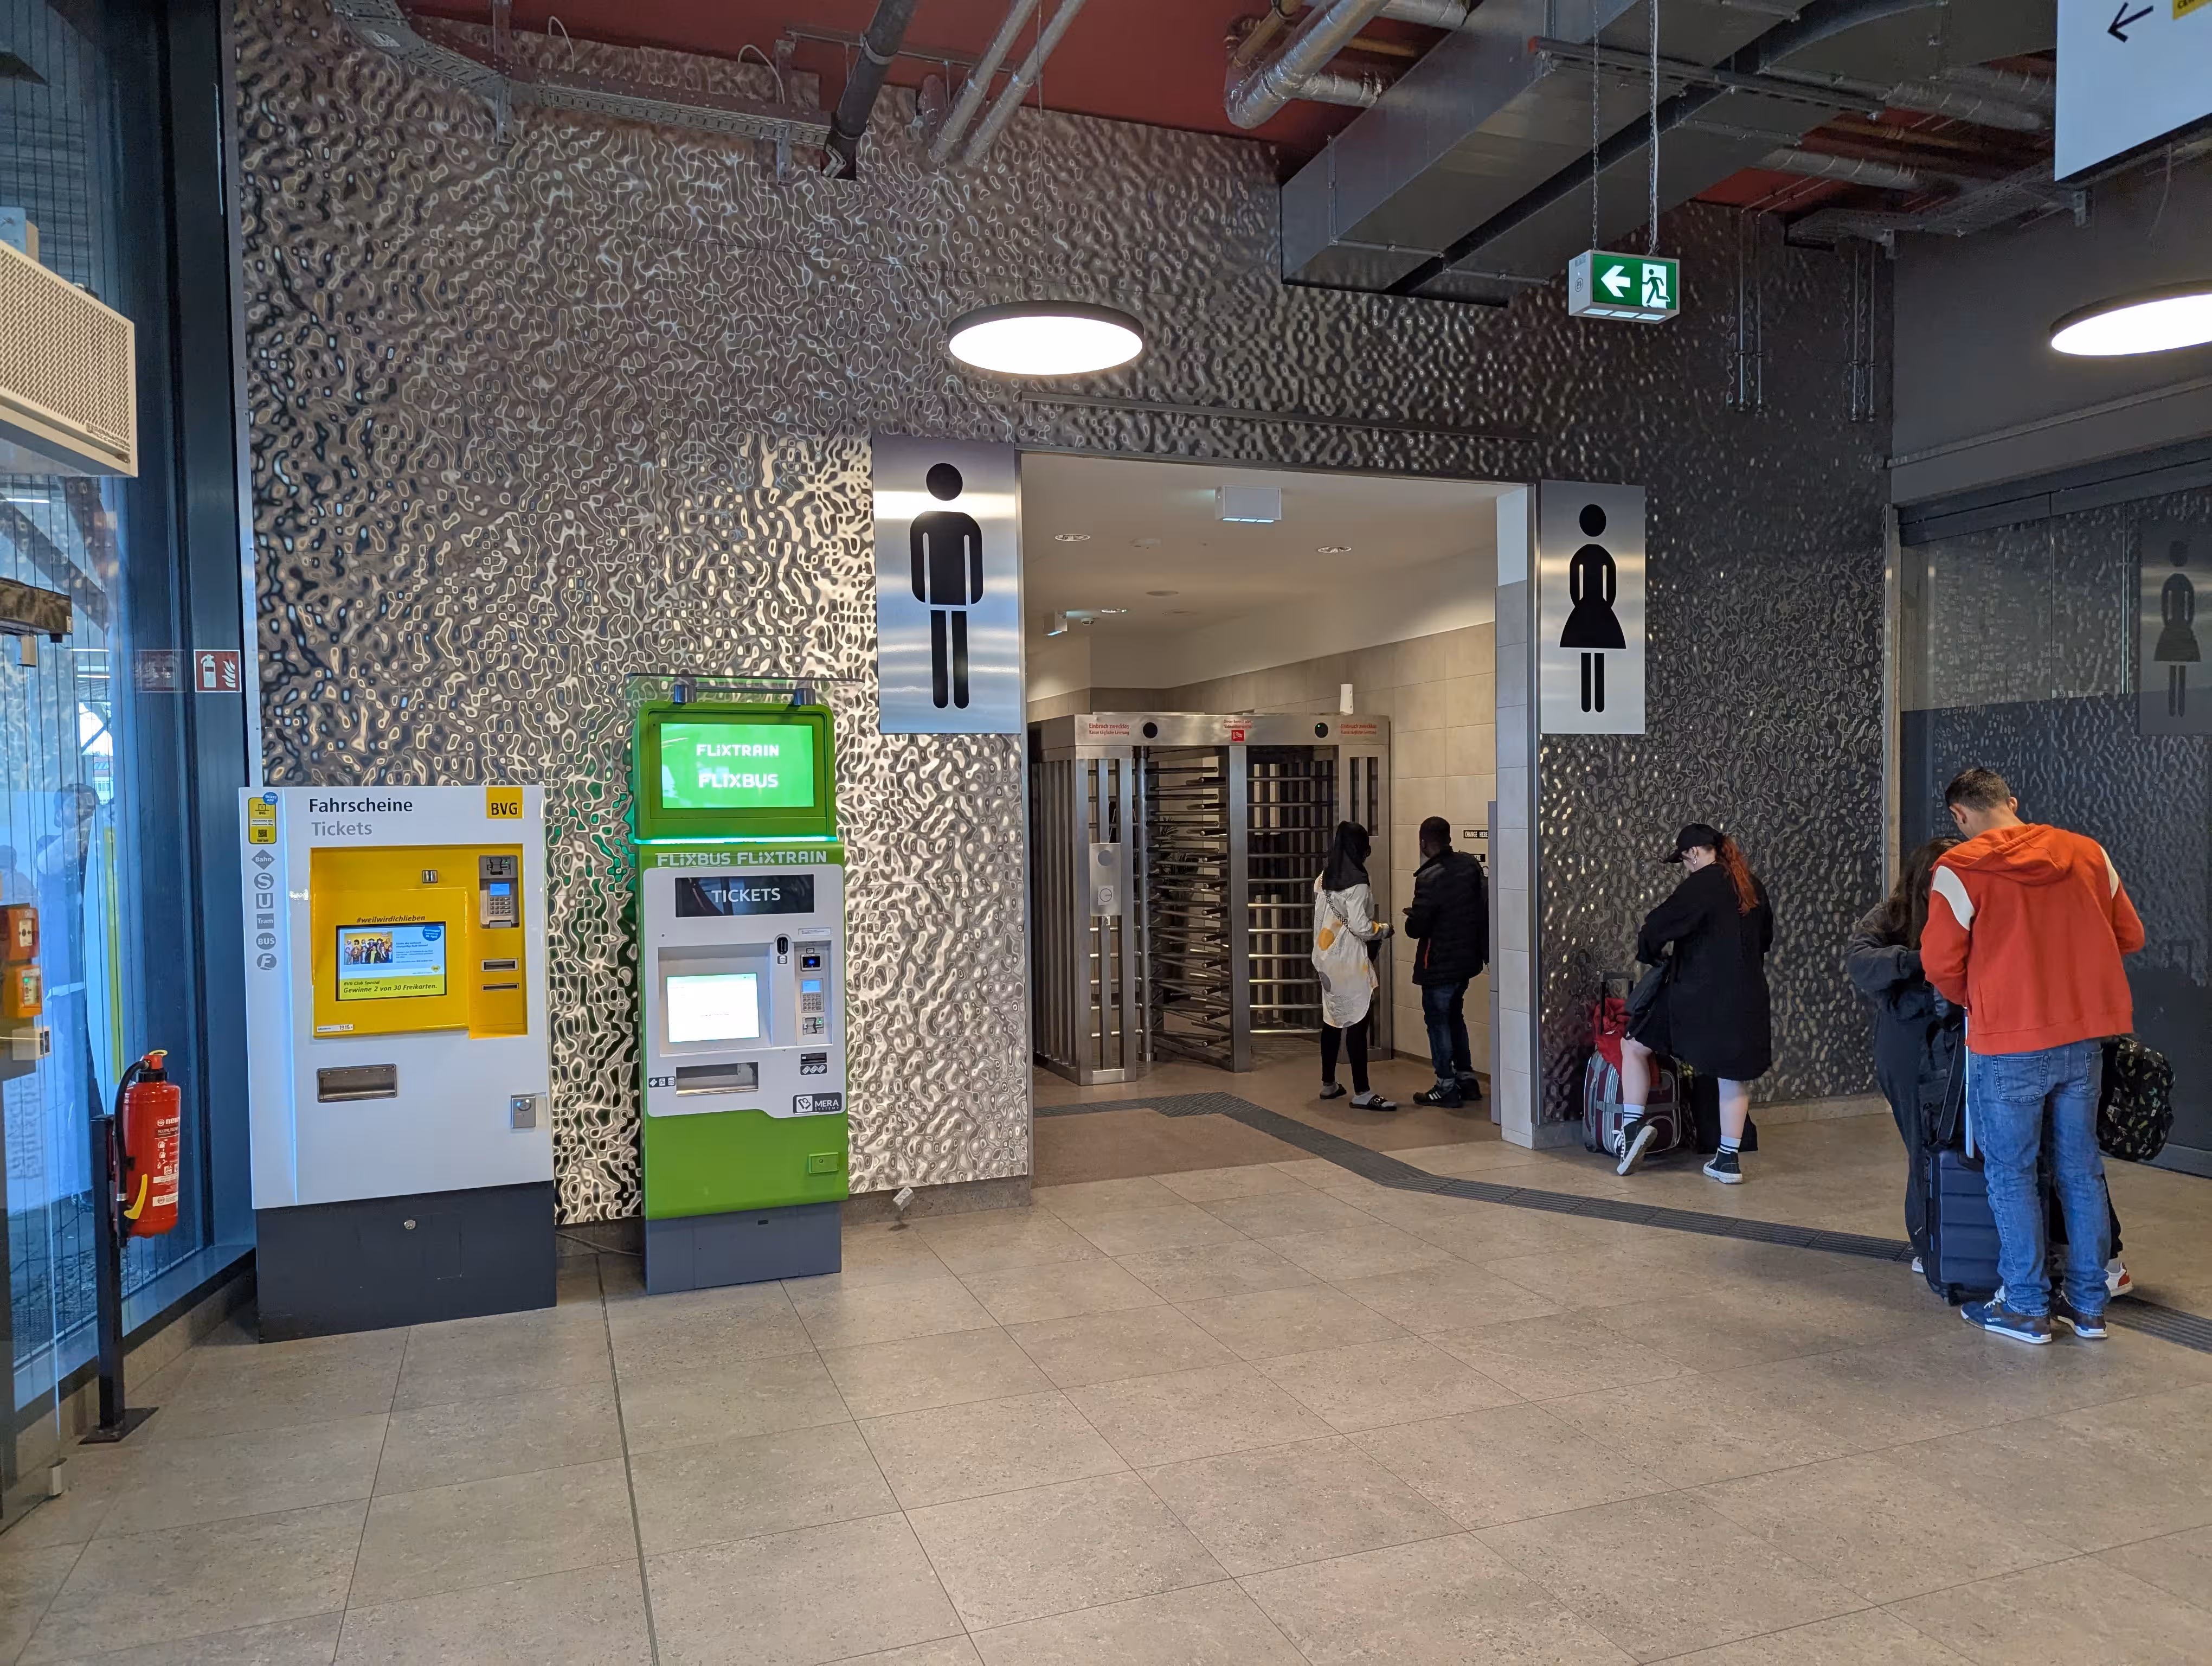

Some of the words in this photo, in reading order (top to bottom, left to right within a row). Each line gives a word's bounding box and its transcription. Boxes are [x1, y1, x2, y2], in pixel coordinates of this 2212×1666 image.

[309, 798, 413, 812] Fahrscheine
[490, 802, 518, 816] BVG
[311, 821, 372, 836] Tickets
[258, 874, 272, 889] S
[258, 894, 271, 908] U
[711, 887, 781, 904] TICKETS
[356, 914, 426, 923] #weilwirdichlieben
[814, 1099, 839, 1108] MERA
